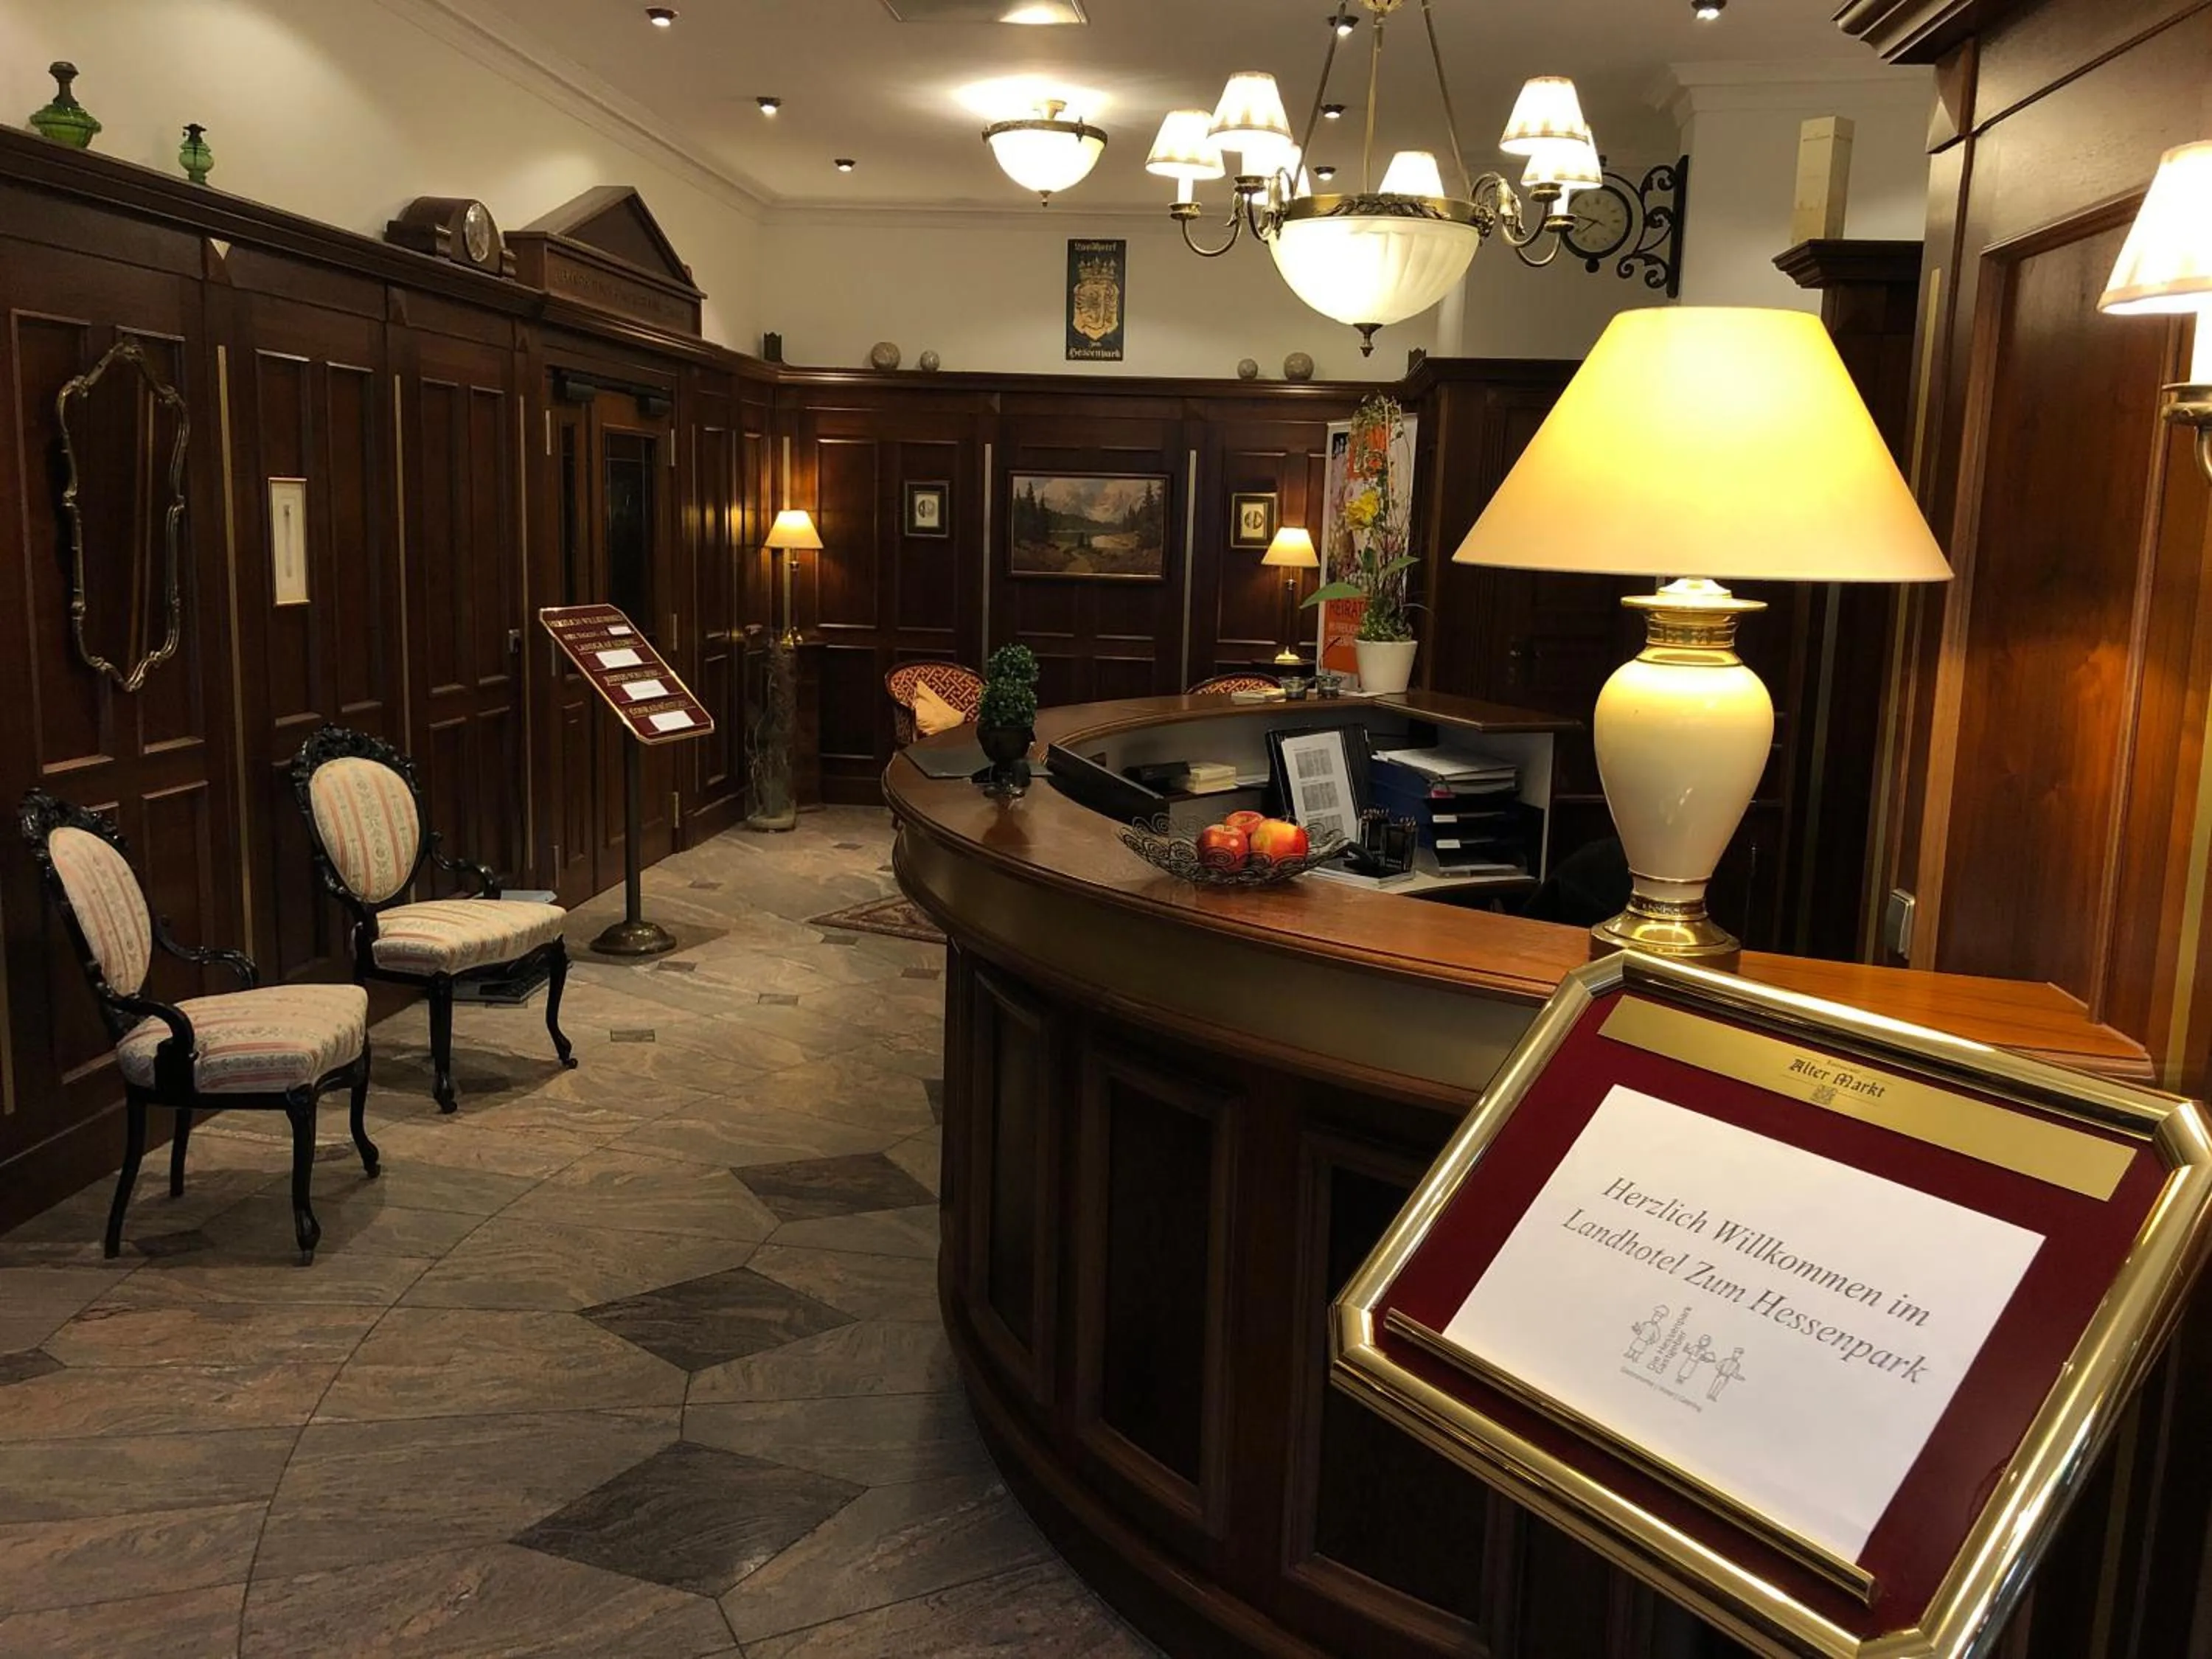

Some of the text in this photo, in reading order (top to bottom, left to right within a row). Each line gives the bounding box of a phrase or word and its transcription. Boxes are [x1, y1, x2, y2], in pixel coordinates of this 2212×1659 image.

[1789, 1058, 1830, 1081] Alter
[1832, 1073, 1885, 1098] Markt
[1562, 1208, 1929, 1383] Landhotel Zum Hessenpark
[1603, 1177, 1930, 1326] Herzlich Willkommen im
